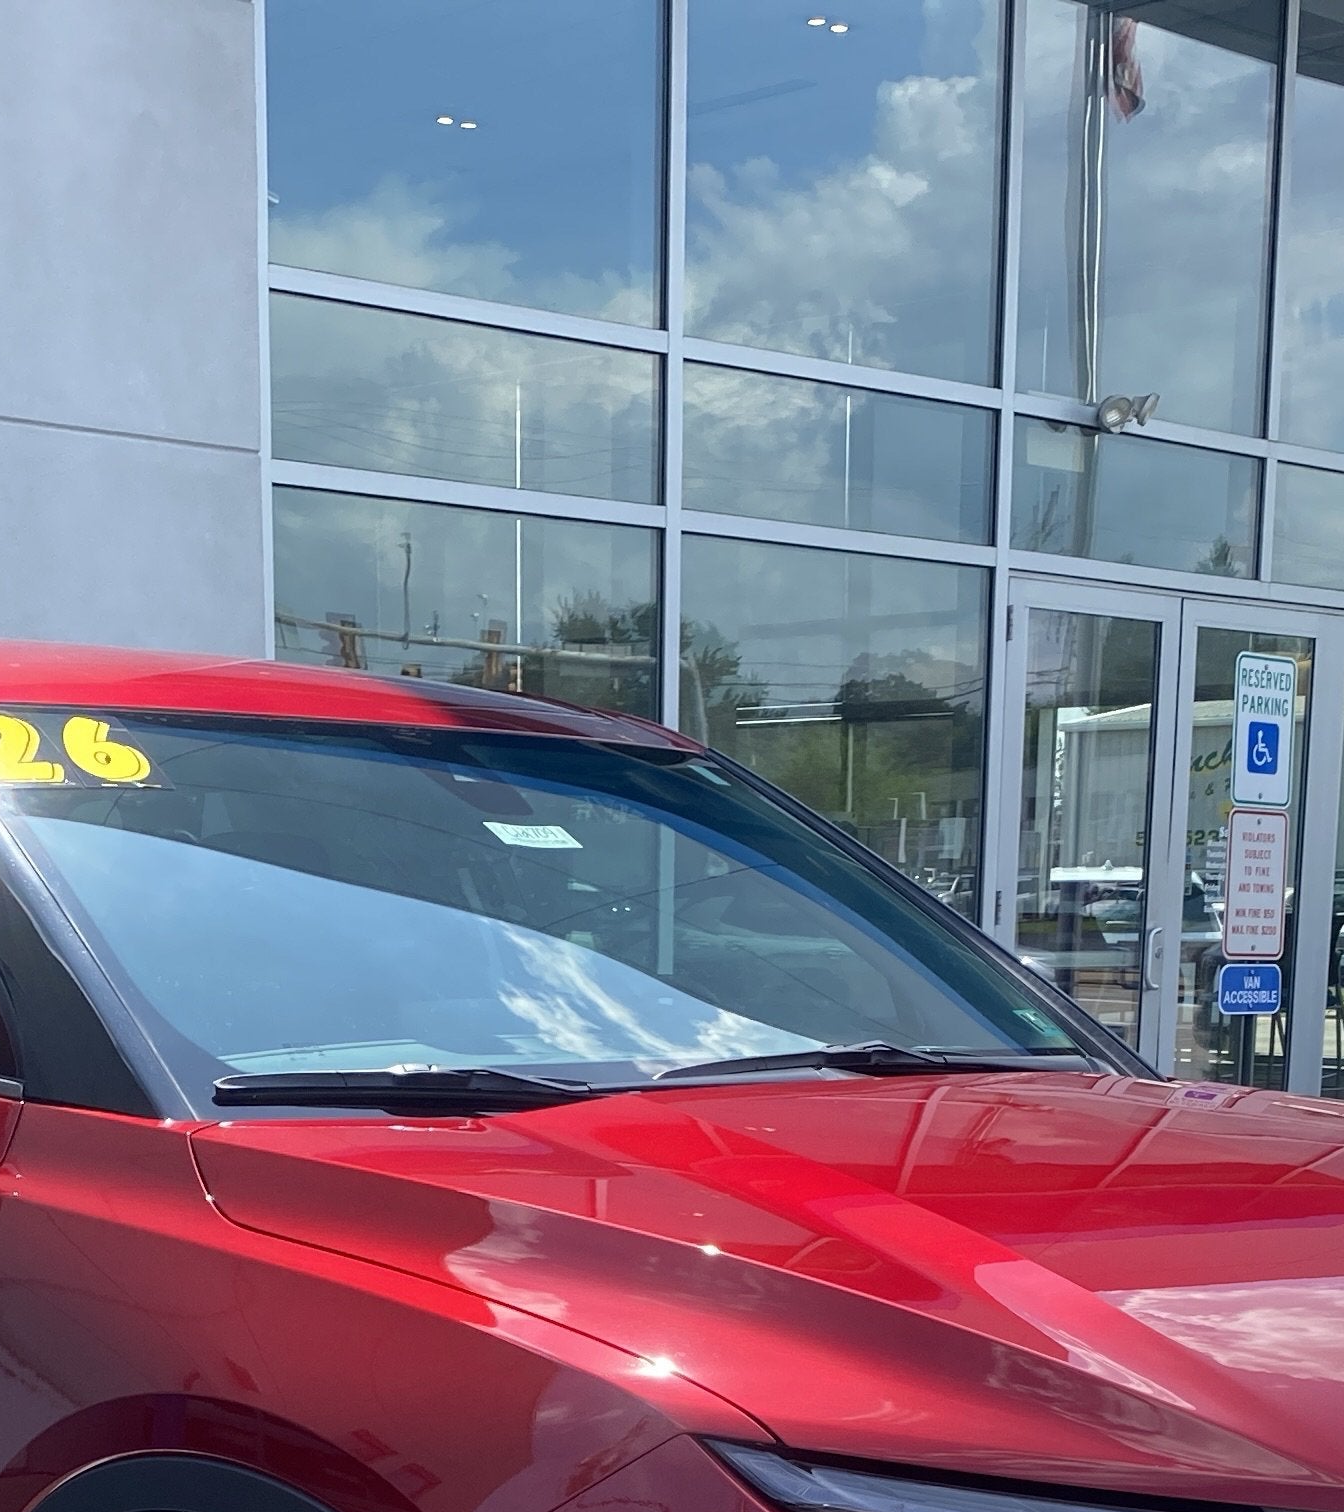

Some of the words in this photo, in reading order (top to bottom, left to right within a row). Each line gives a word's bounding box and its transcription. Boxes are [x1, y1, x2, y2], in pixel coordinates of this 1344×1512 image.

[1241, 668, 1291, 692] RESERVED
[1242, 694, 1289, 717] PARKING
[1242, 832, 1276, 844] VIOLATORS
[1244, 849, 1271, 860] SUBJECT
[1244, 866, 1252, 876] TO
[1255, 867, 1270, 877] FINE
[1238, 882, 1250, 893] AND
[1253, 883, 1274, 894] TOWING
[1248, 909, 1261, 919] FINE
[1246, 925, 1259, 935] FINE
[1243, 975, 1261, 990] VAN
[1223, 990, 1278, 1004] ACCESSIBLE
